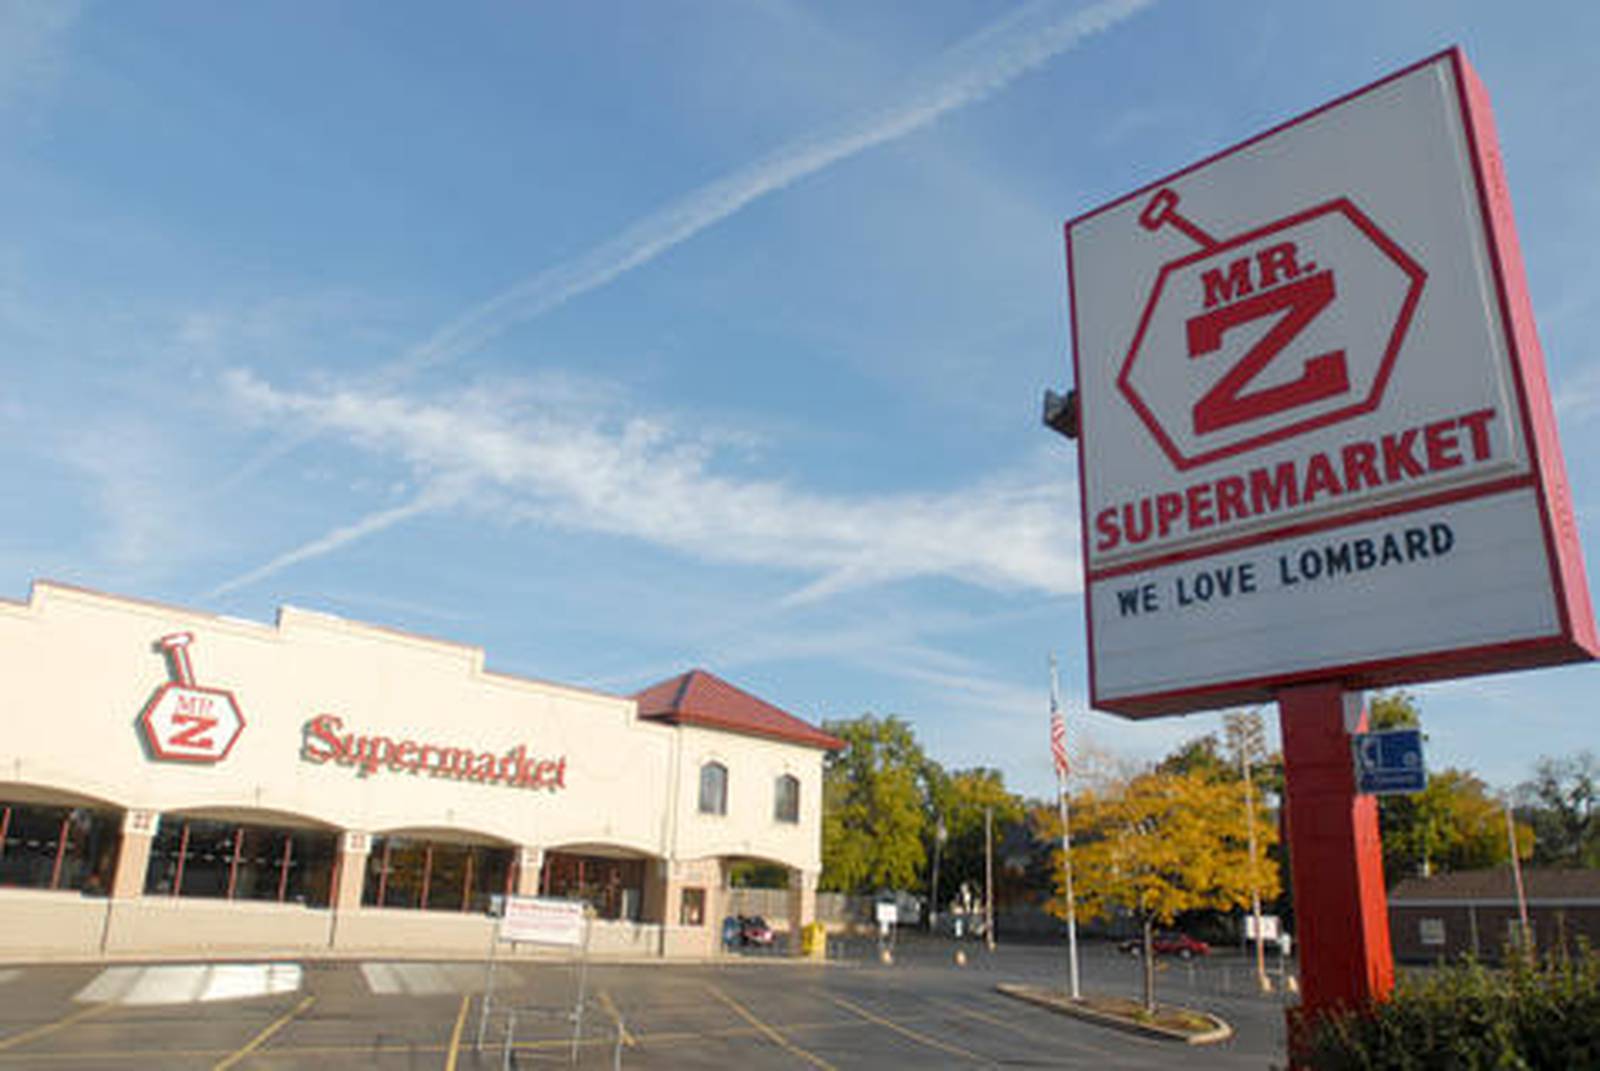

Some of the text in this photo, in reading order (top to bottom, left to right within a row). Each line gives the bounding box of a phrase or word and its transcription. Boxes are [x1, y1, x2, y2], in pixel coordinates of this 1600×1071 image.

[1201, 242, 1317, 308] MR.
[1186, 269, 1349, 435] Z
[1096, 409, 1496, 551] SUPERMARKET
[1117, 523, 1454, 617] WE LOVE LOMBARD
[168, 715, 218, 749] Z
[303, 714, 566, 790] Supermarket
